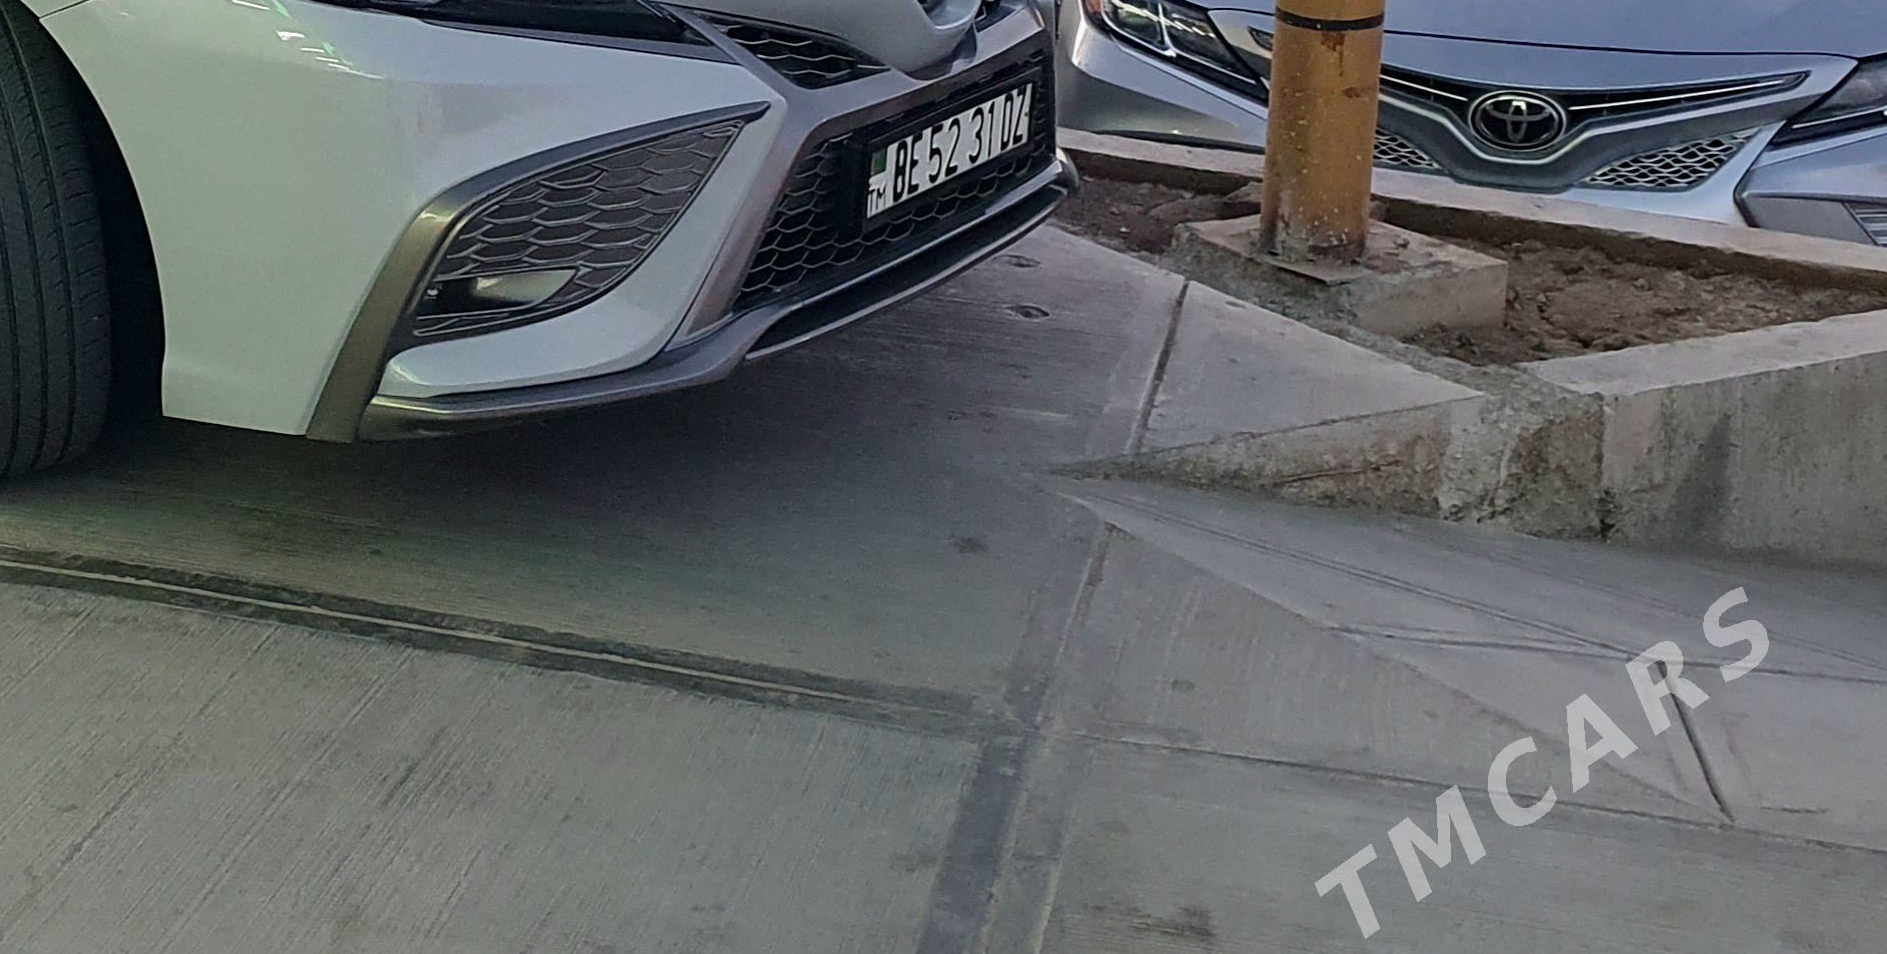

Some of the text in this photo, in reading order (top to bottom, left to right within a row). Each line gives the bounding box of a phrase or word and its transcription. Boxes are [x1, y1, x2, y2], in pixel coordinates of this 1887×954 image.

[893, 131, 924, 202] BE
[928, 117, 961, 184] 52
[968, 101, 996, 165] 31
[1000, 84, 1028, 152] DZ
